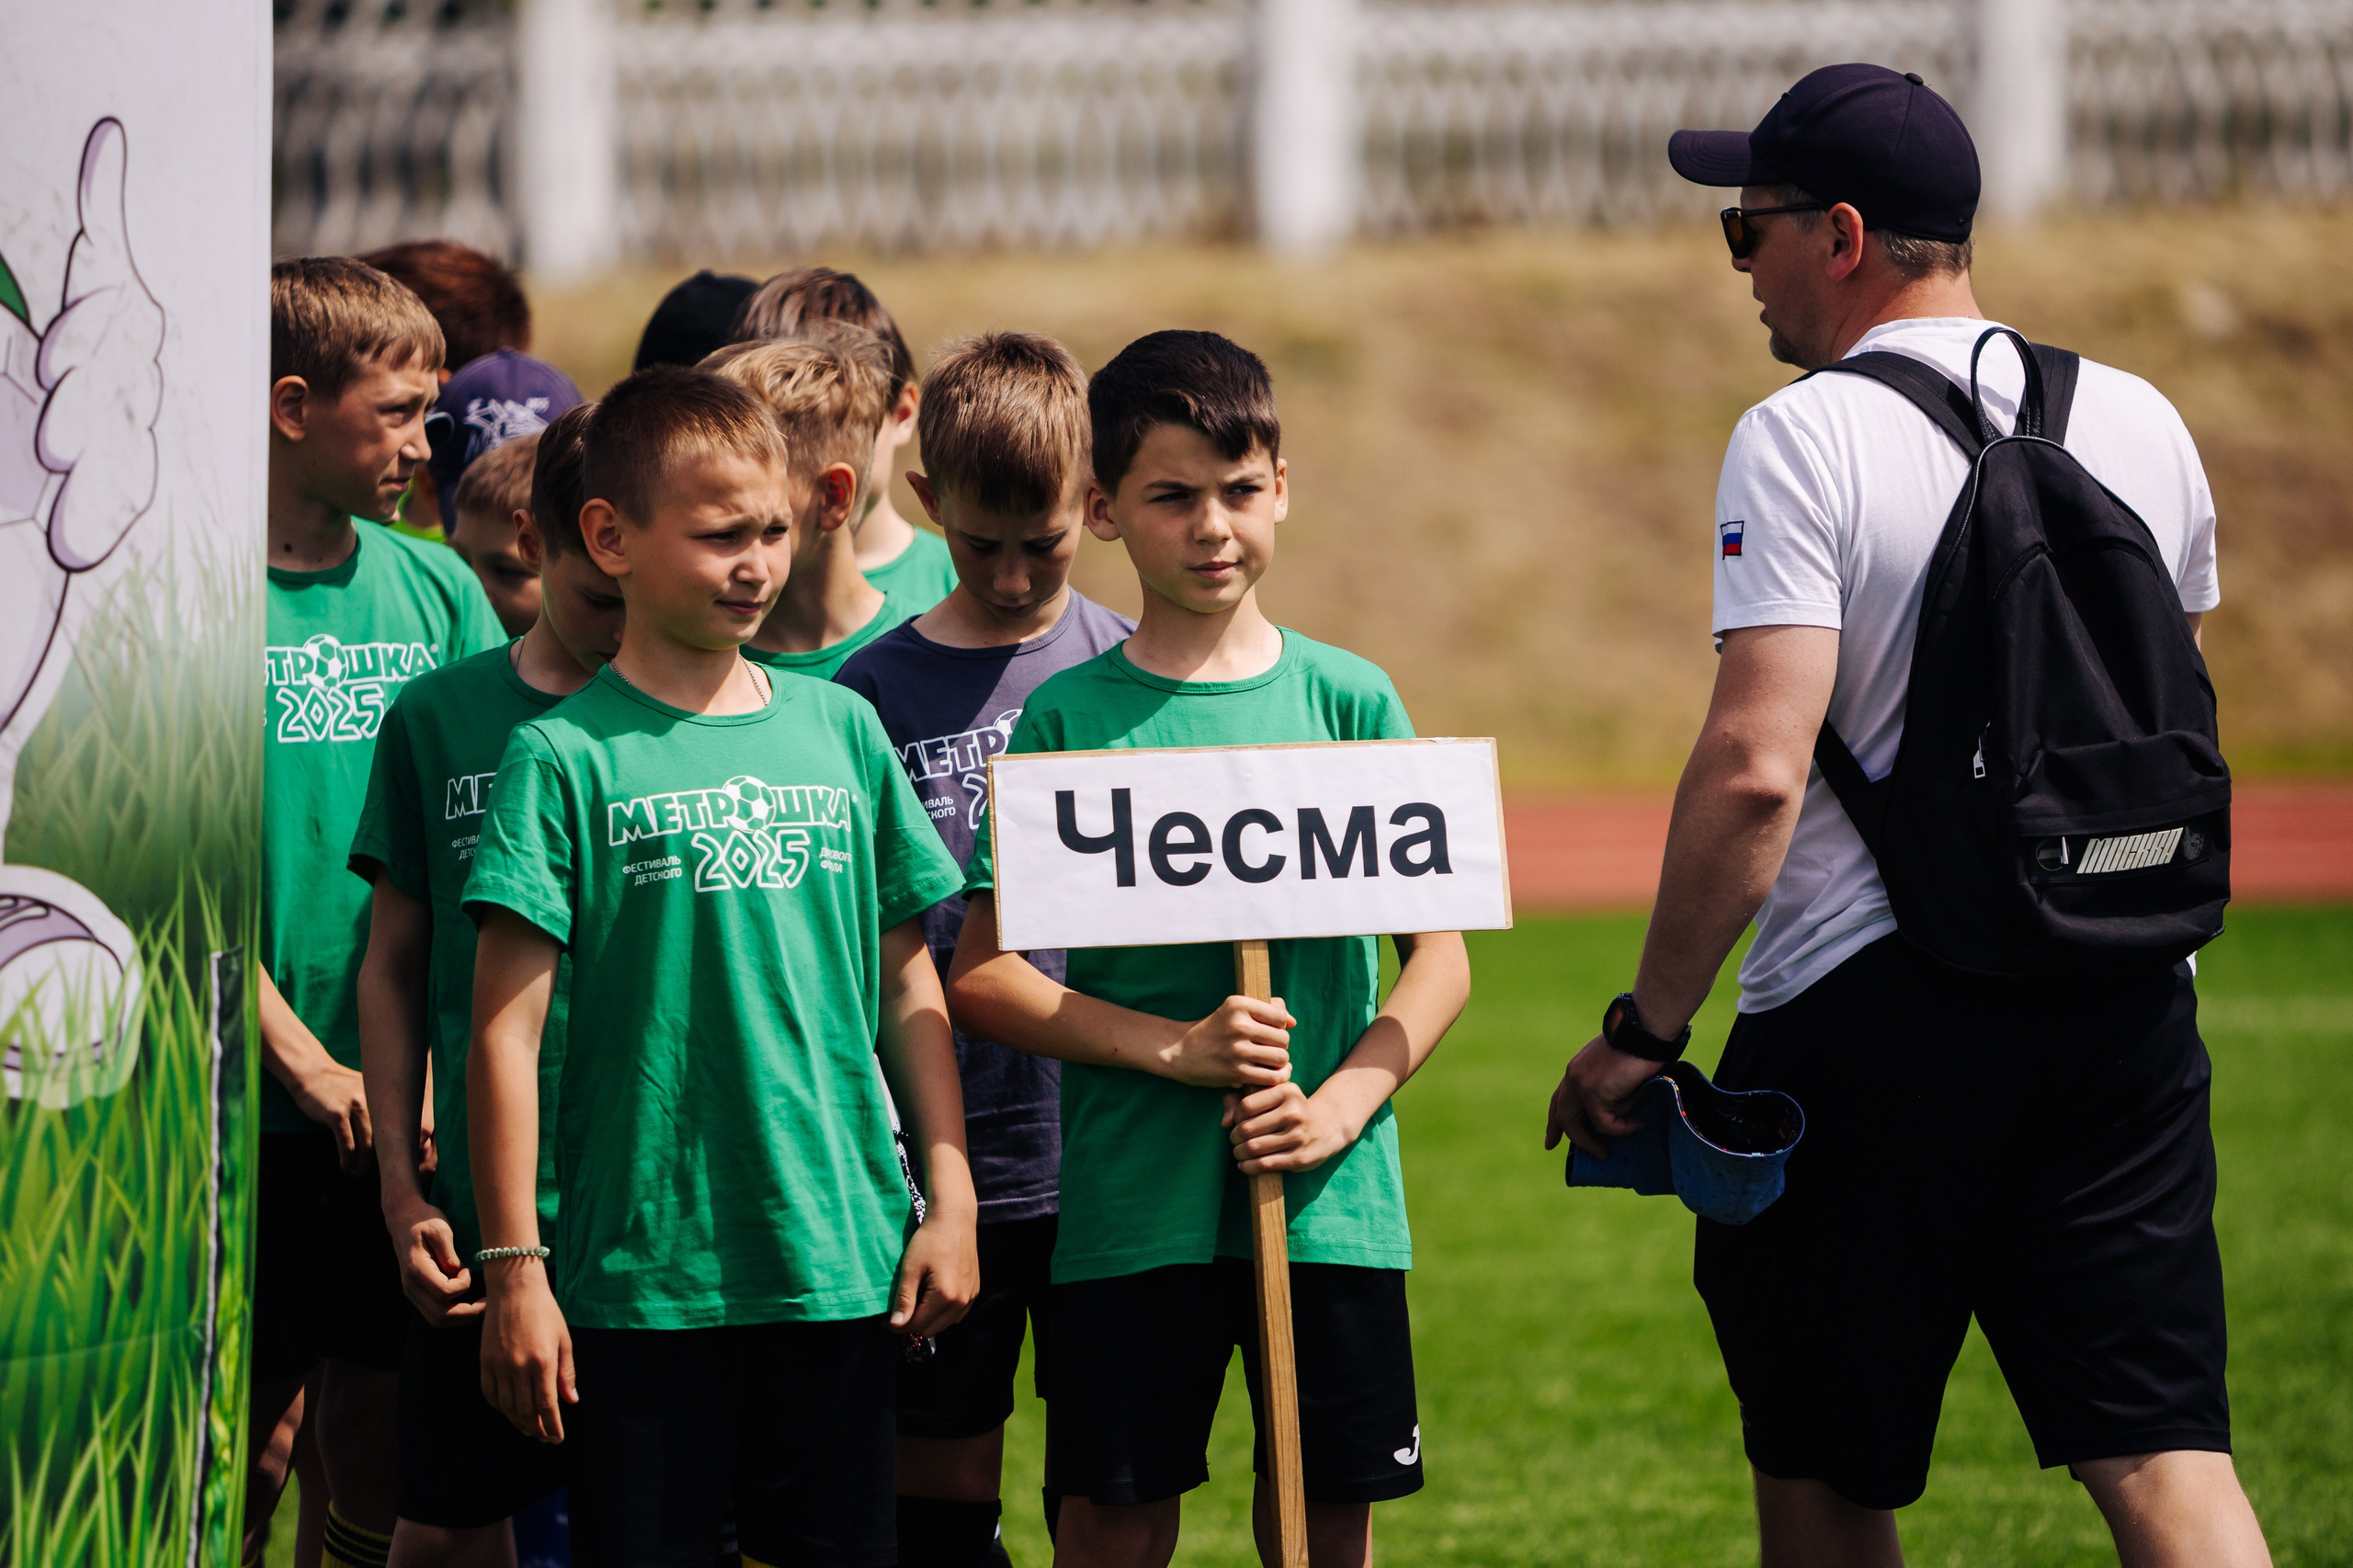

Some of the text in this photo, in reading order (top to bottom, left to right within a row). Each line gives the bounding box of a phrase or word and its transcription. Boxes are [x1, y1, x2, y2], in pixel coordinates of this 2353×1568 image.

[264, 634, 437, 689] ТРОШКА
[276, 683, 384, 743] 2025
[608, 776, 851, 846] МЕТРОШКА
[1054, 788, 1453, 887] Чесма
[622, 855, 682, 874] ФЕСТИВАЛЬ
[634, 867, 683, 887] ДЕТСКОГО
[690, 829, 811, 892] 2025
